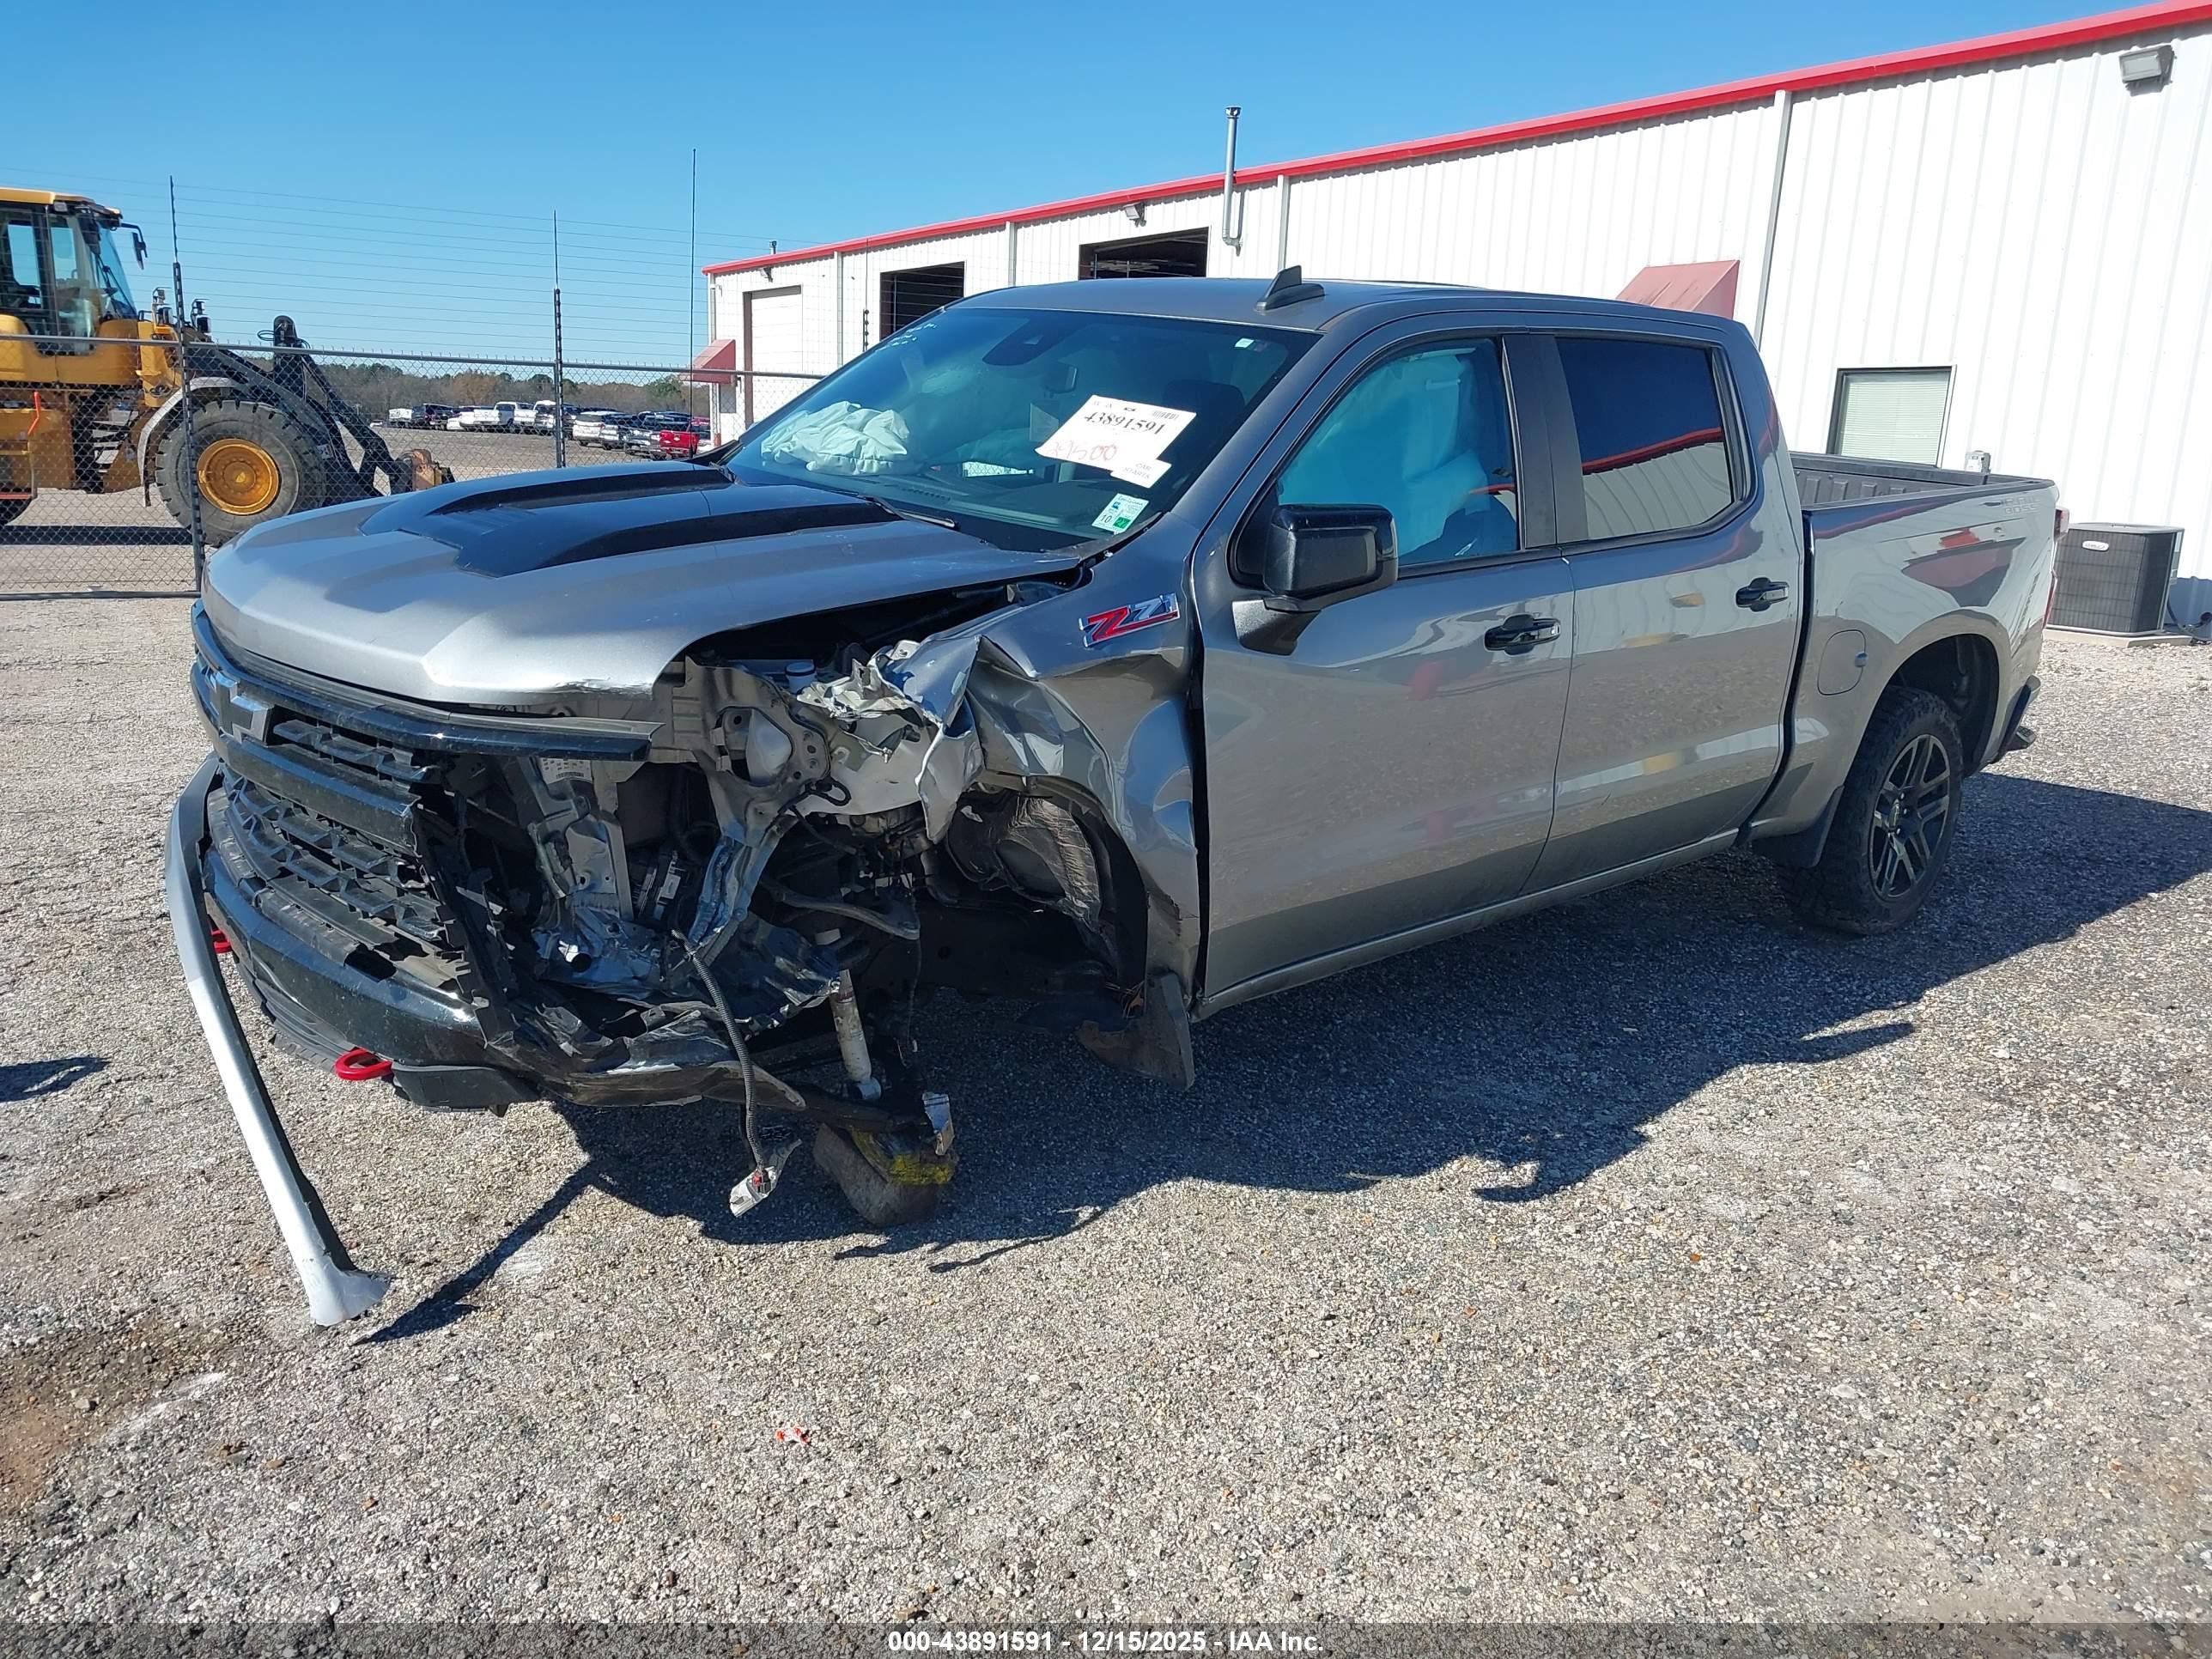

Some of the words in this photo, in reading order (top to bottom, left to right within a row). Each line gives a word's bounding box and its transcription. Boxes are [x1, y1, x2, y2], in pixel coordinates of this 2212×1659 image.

[1084, 411, 1165, 434] 43891591
[1100, 514, 1113, 524] 10
[1079, 592, 1180, 647] Z71
